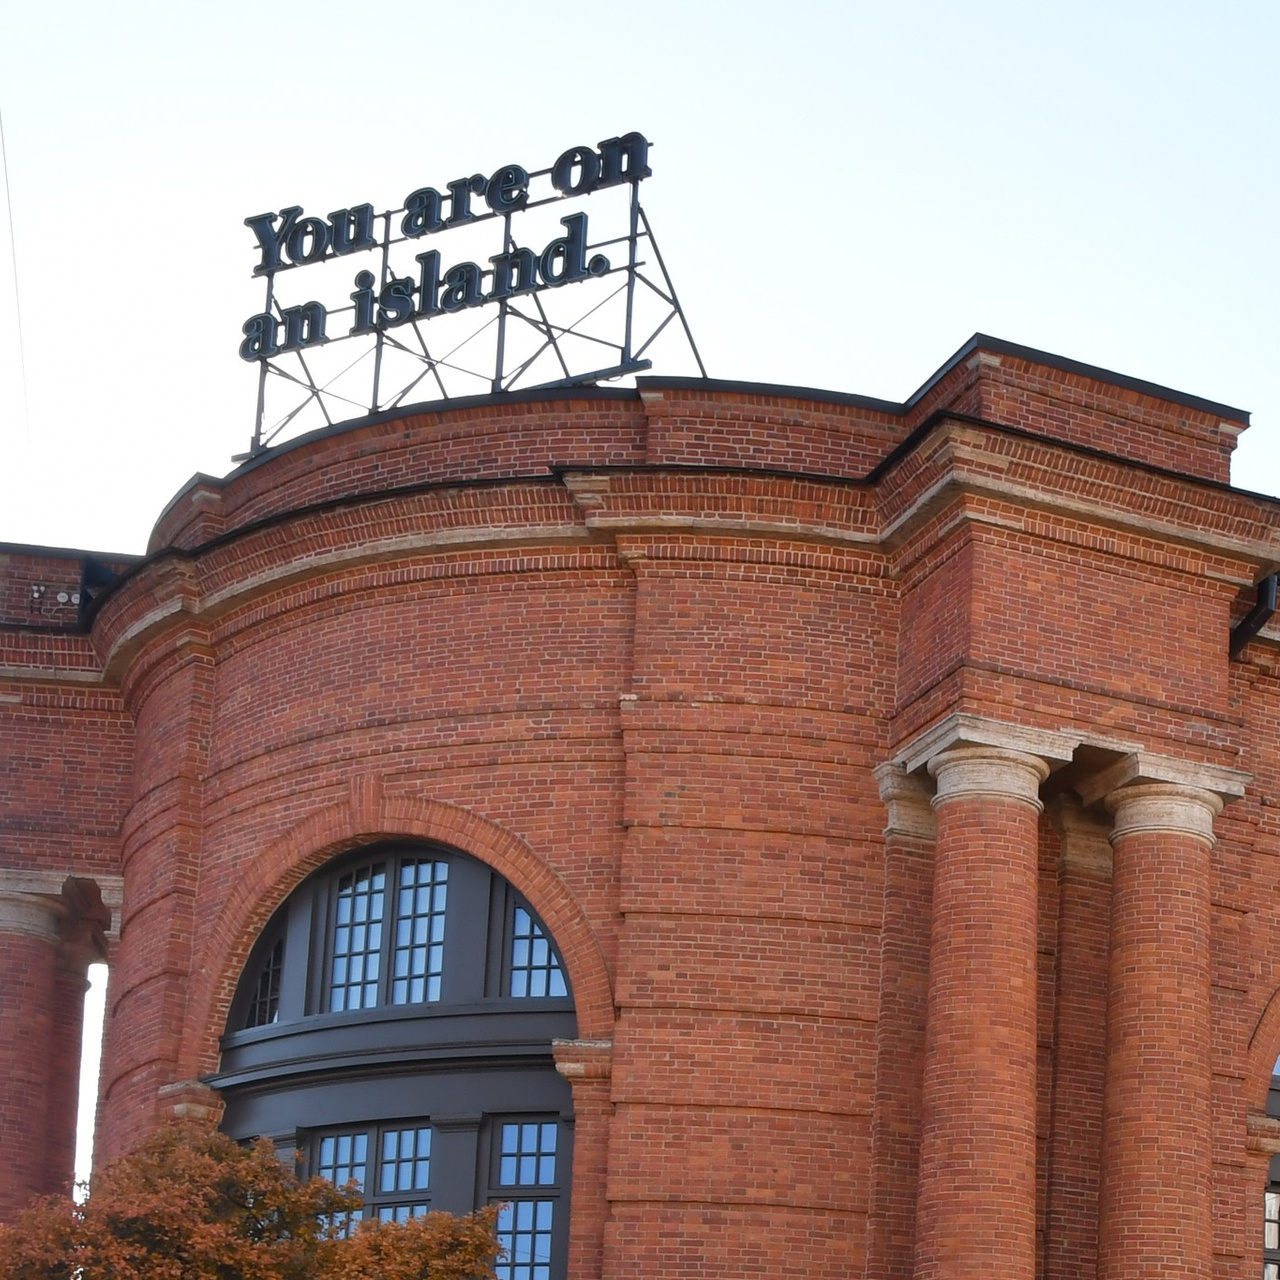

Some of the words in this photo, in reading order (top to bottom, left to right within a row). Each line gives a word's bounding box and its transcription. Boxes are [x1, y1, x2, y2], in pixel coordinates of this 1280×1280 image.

[244, 202, 376, 276] You
[401, 164, 530, 239] are
[551, 131, 653, 197] on
[239, 301, 329, 362] an
[349, 212, 610, 336] island.
